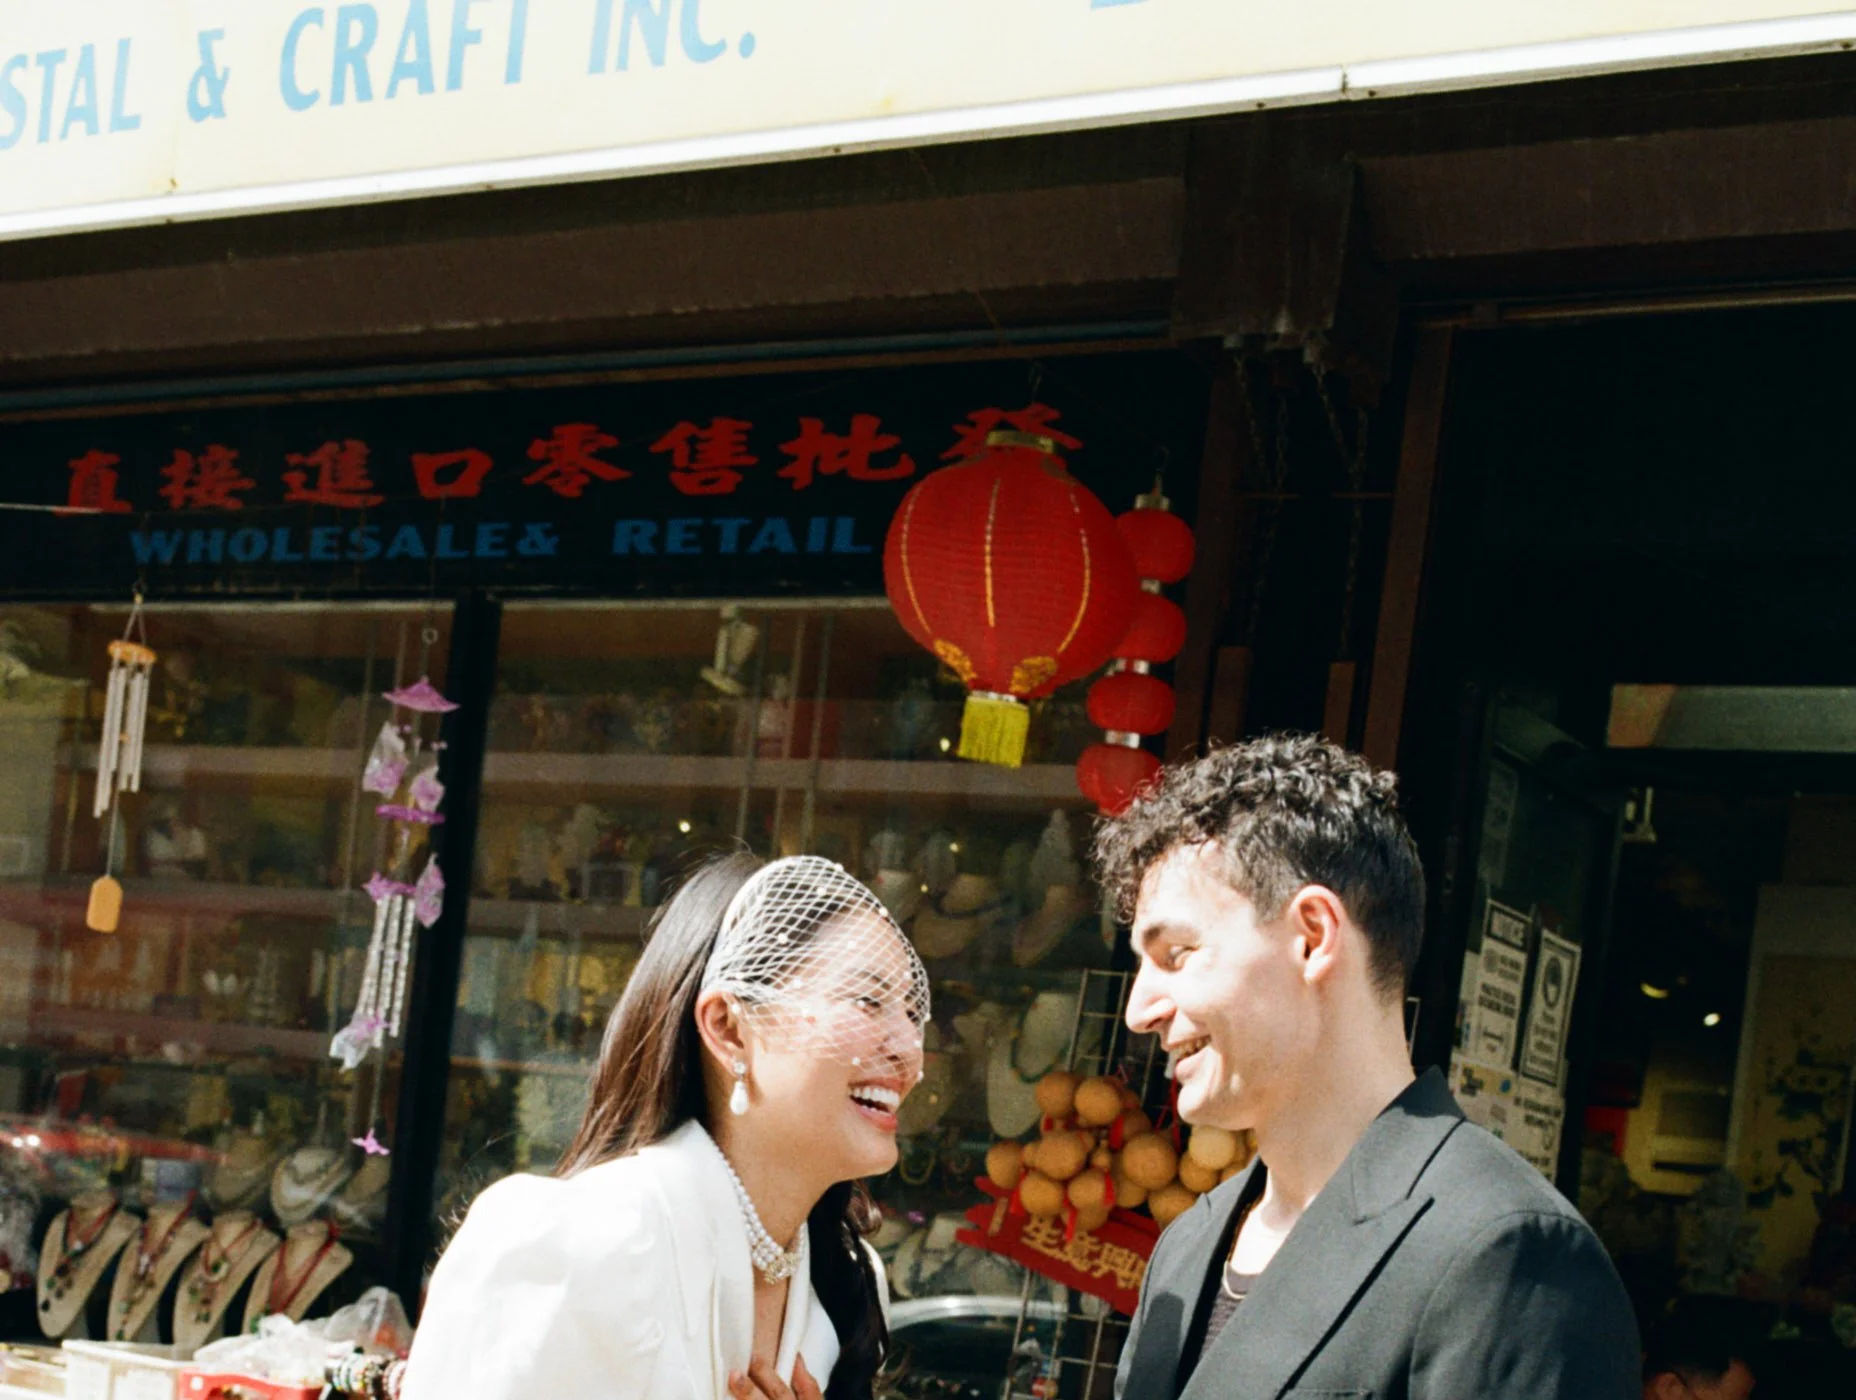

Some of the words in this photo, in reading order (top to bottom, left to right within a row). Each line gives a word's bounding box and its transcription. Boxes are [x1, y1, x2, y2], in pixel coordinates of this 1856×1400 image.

[0, 36, 143, 151] STAL
[187, 27, 230, 123] &
[279, 0, 529, 112] CRAFT
[588, 0, 756, 74] INC.
[611, 516, 874, 556] RETAIL
